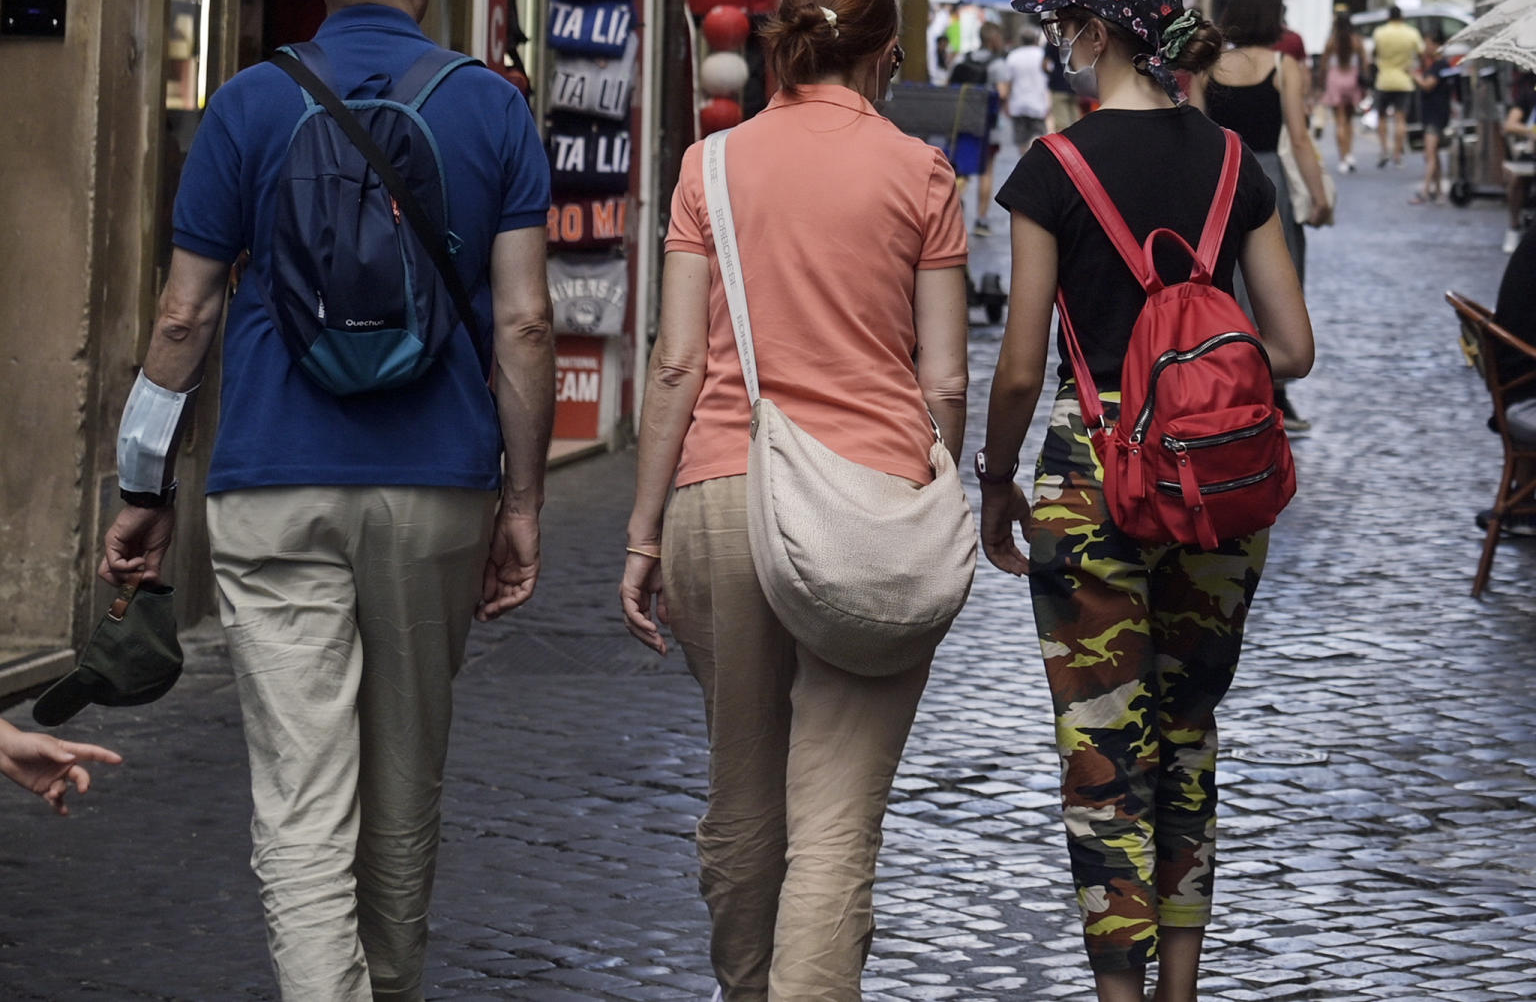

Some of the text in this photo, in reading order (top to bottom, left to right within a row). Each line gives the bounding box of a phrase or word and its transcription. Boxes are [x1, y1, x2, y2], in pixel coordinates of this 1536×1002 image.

[549, 2, 584, 39] TA
[552, 70, 585, 107] TA
[345, 318, 385, 327] Quechua
